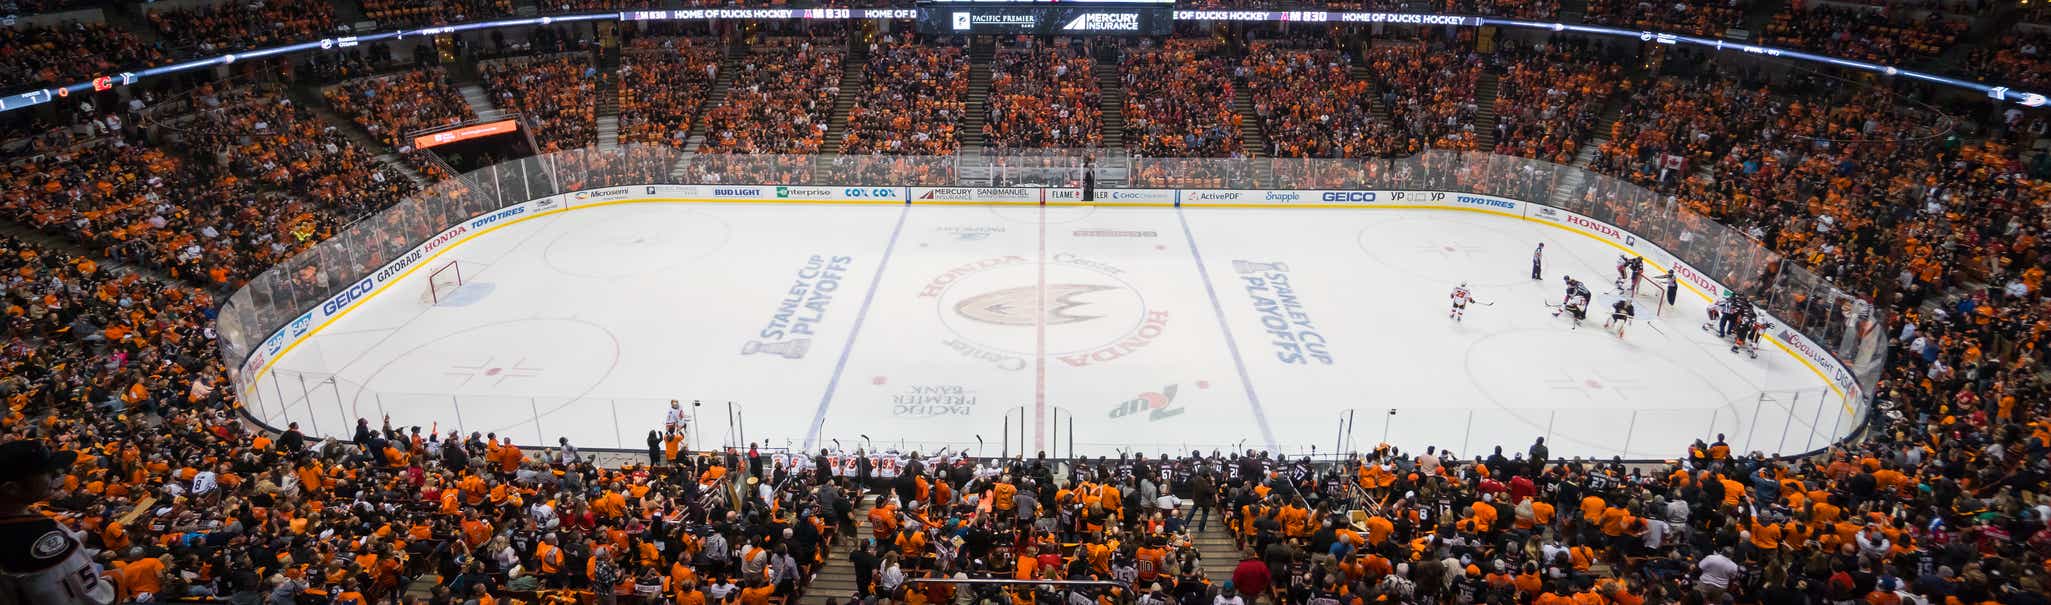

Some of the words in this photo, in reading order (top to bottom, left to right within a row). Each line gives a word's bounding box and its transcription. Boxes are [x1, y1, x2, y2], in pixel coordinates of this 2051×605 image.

[674, 10, 704, 19] HOME
[705, 10, 719, 18] OF
[720, 9, 752, 19] DUCKS
[753, 9, 793, 19] HOCKEY
[865, 10, 892, 18] HOME
[894, 10, 908, 18] OF
[1086, 13, 1139, 22] MERCURY
[1180, 11, 1194, 20] OF
[1195, 11, 1228, 20] DUCKS
[1229, 11, 1269, 20] HOCKEY
[1342, 12, 1370, 22] HOME
[1371, 13, 1386, 22] OF
[1388, 13, 1421, 24] DUCKS
[1422, 14, 1465, 25] HOCKEY
[1086, 22, 1139, 30] INSURANCE
[714, 188, 734, 196] BUD
[734, 188, 760, 196] LIGHT
[778, 188, 831, 197] enterprise
[845, 188, 868, 197] COX
[873, 188, 896, 197] COX
[998, 188, 1029, 196] MANUEL
[1052, 191, 1073, 199] FLAME
[1265, 191, 1300, 202] Snapple
[1322, 192, 1376, 202] GEICO
[1457, 195, 1485, 204] TOYO
[1486, 199, 1515, 209] TIRES
[471, 215, 496, 229] TOYO
[497, 206, 525, 219] TIRES
[1567, 215, 1622, 240] HONDA
[424, 226, 467, 253] HONDA
[377, 249, 422, 282] GATORADE
[1672, 261, 1718, 297] HONDA
[323, 278, 373, 317] GEICO
[760, 280, 811, 341] STANLEY
[799, 254, 824, 280] CUP
[790, 255, 852, 336] PLAYOFFS
[1240, 276, 1307, 365] PLAYOFFS
[1264, 272, 1315, 329] STANLEY
[1298, 330, 1333, 365] CUP
[1056, 309, 1168, 368] HONDA
[1161, 469, 1172, 480] 67
[1590, 476, 1607, 489] 27
[1419, 508, 1428, 520] 8
[63, 563, 99, 599] 15
